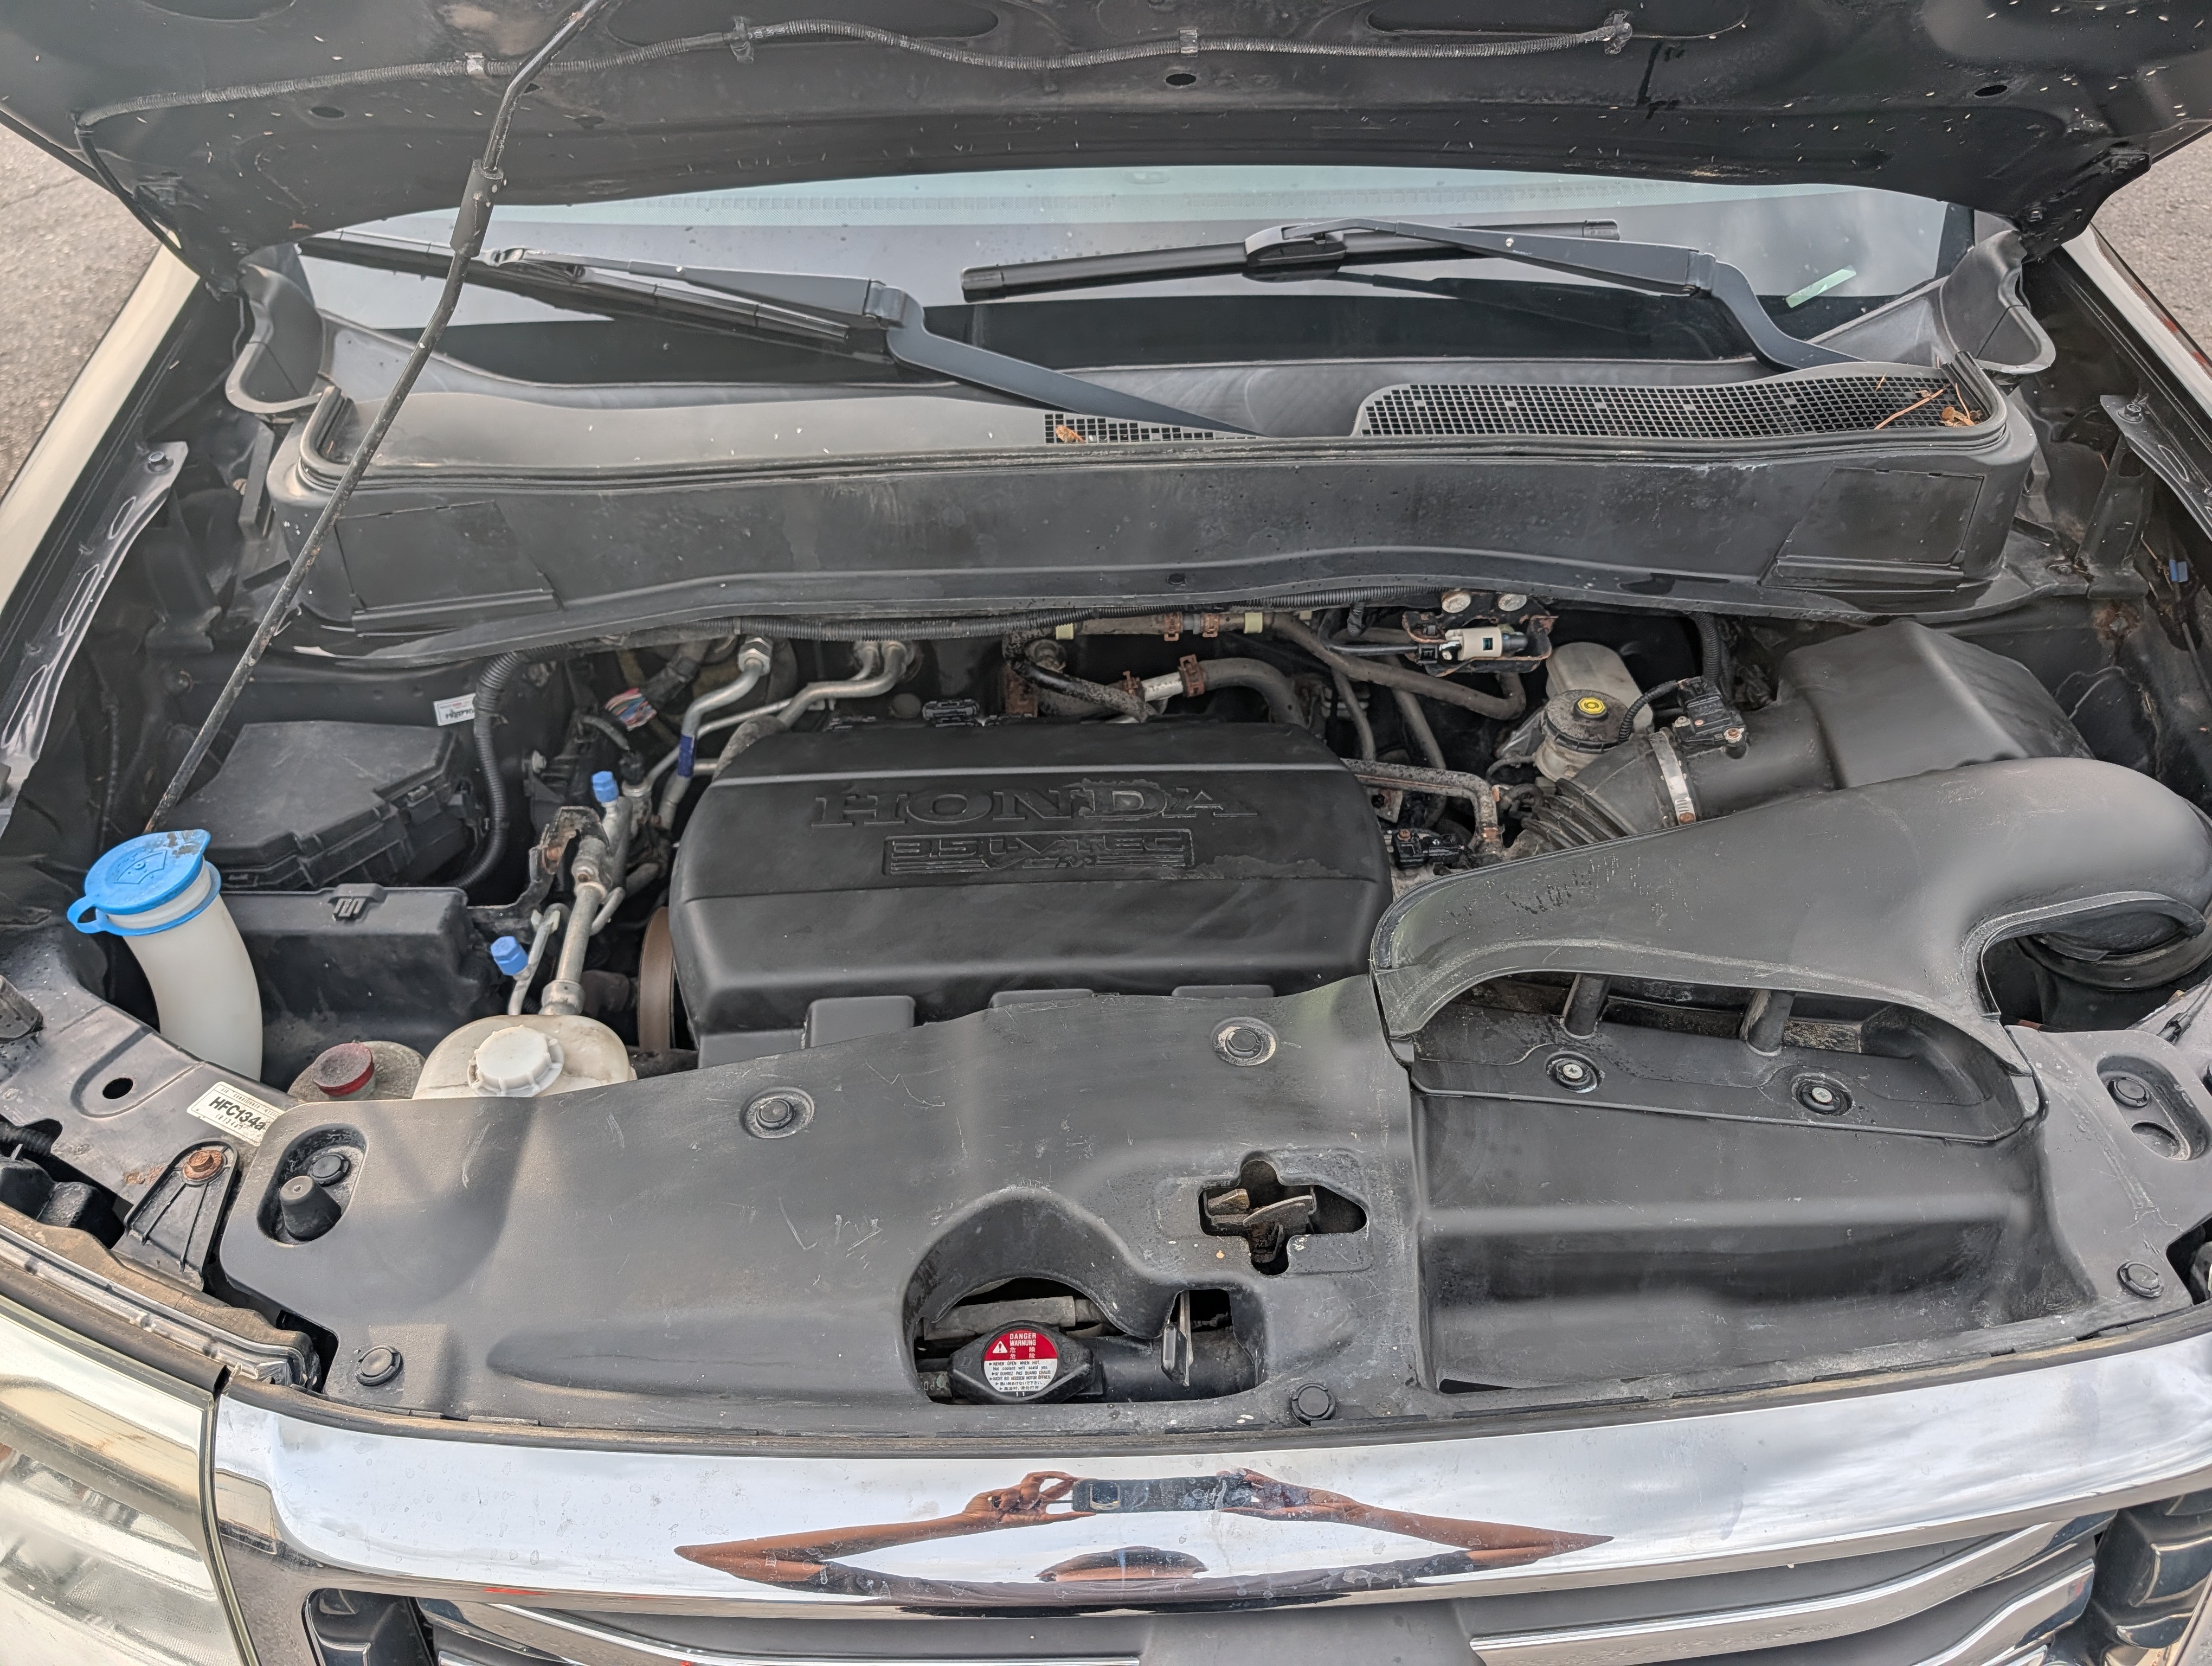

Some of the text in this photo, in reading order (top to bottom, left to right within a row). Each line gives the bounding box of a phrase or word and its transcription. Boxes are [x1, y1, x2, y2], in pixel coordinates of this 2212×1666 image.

[811, 785, 1259, 826] HONDA
[209, 1096, 266, 1131] HFC134a
[265, 1108, 279, 1117] SYSTE
